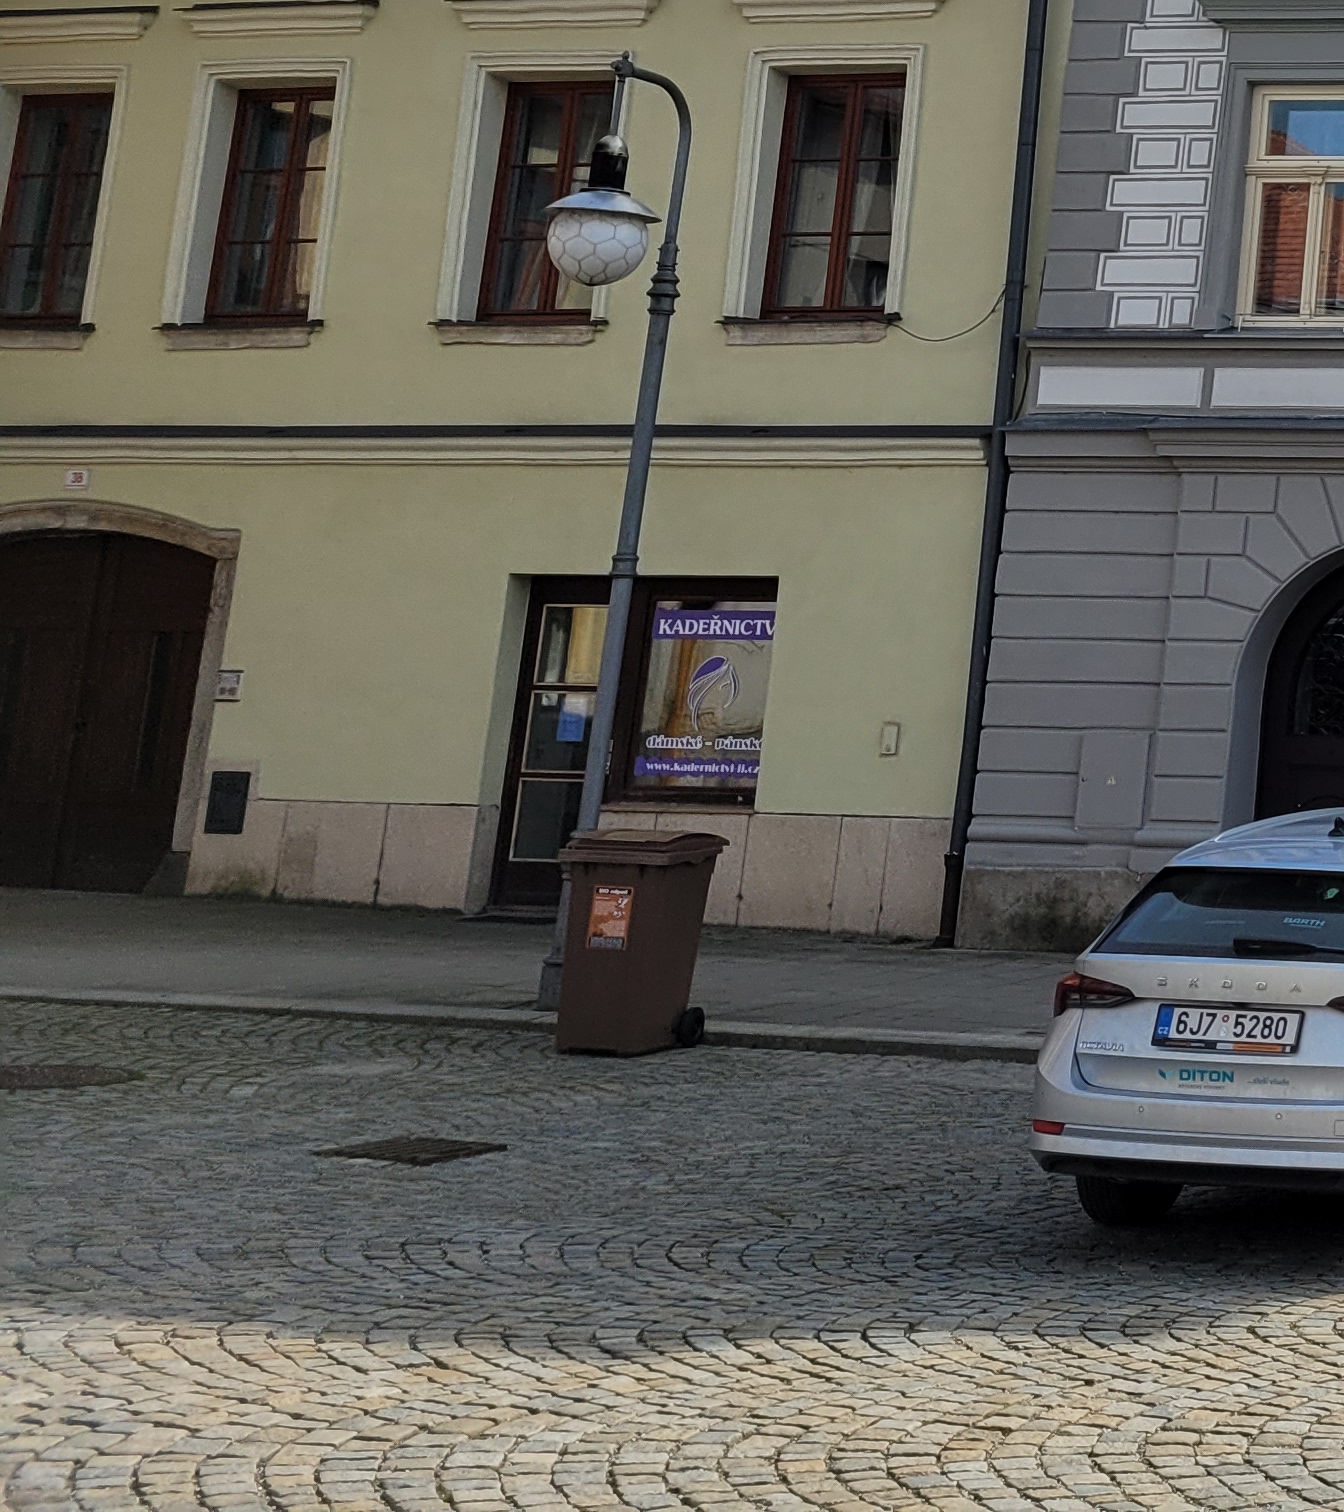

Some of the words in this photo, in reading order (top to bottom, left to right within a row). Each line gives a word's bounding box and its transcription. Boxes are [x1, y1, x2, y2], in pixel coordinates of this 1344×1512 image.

[645, 735, 703, 750] dámské
[1283, 917, 1326, 927] BARTH
[1157, 1026, 1169, 1035] CZ
[1175, 1011, 1218, 1037] 6J7
[1232, 1014, 1288, 1040] 5280
[1178, 1068, 1235, 1083] DITON
